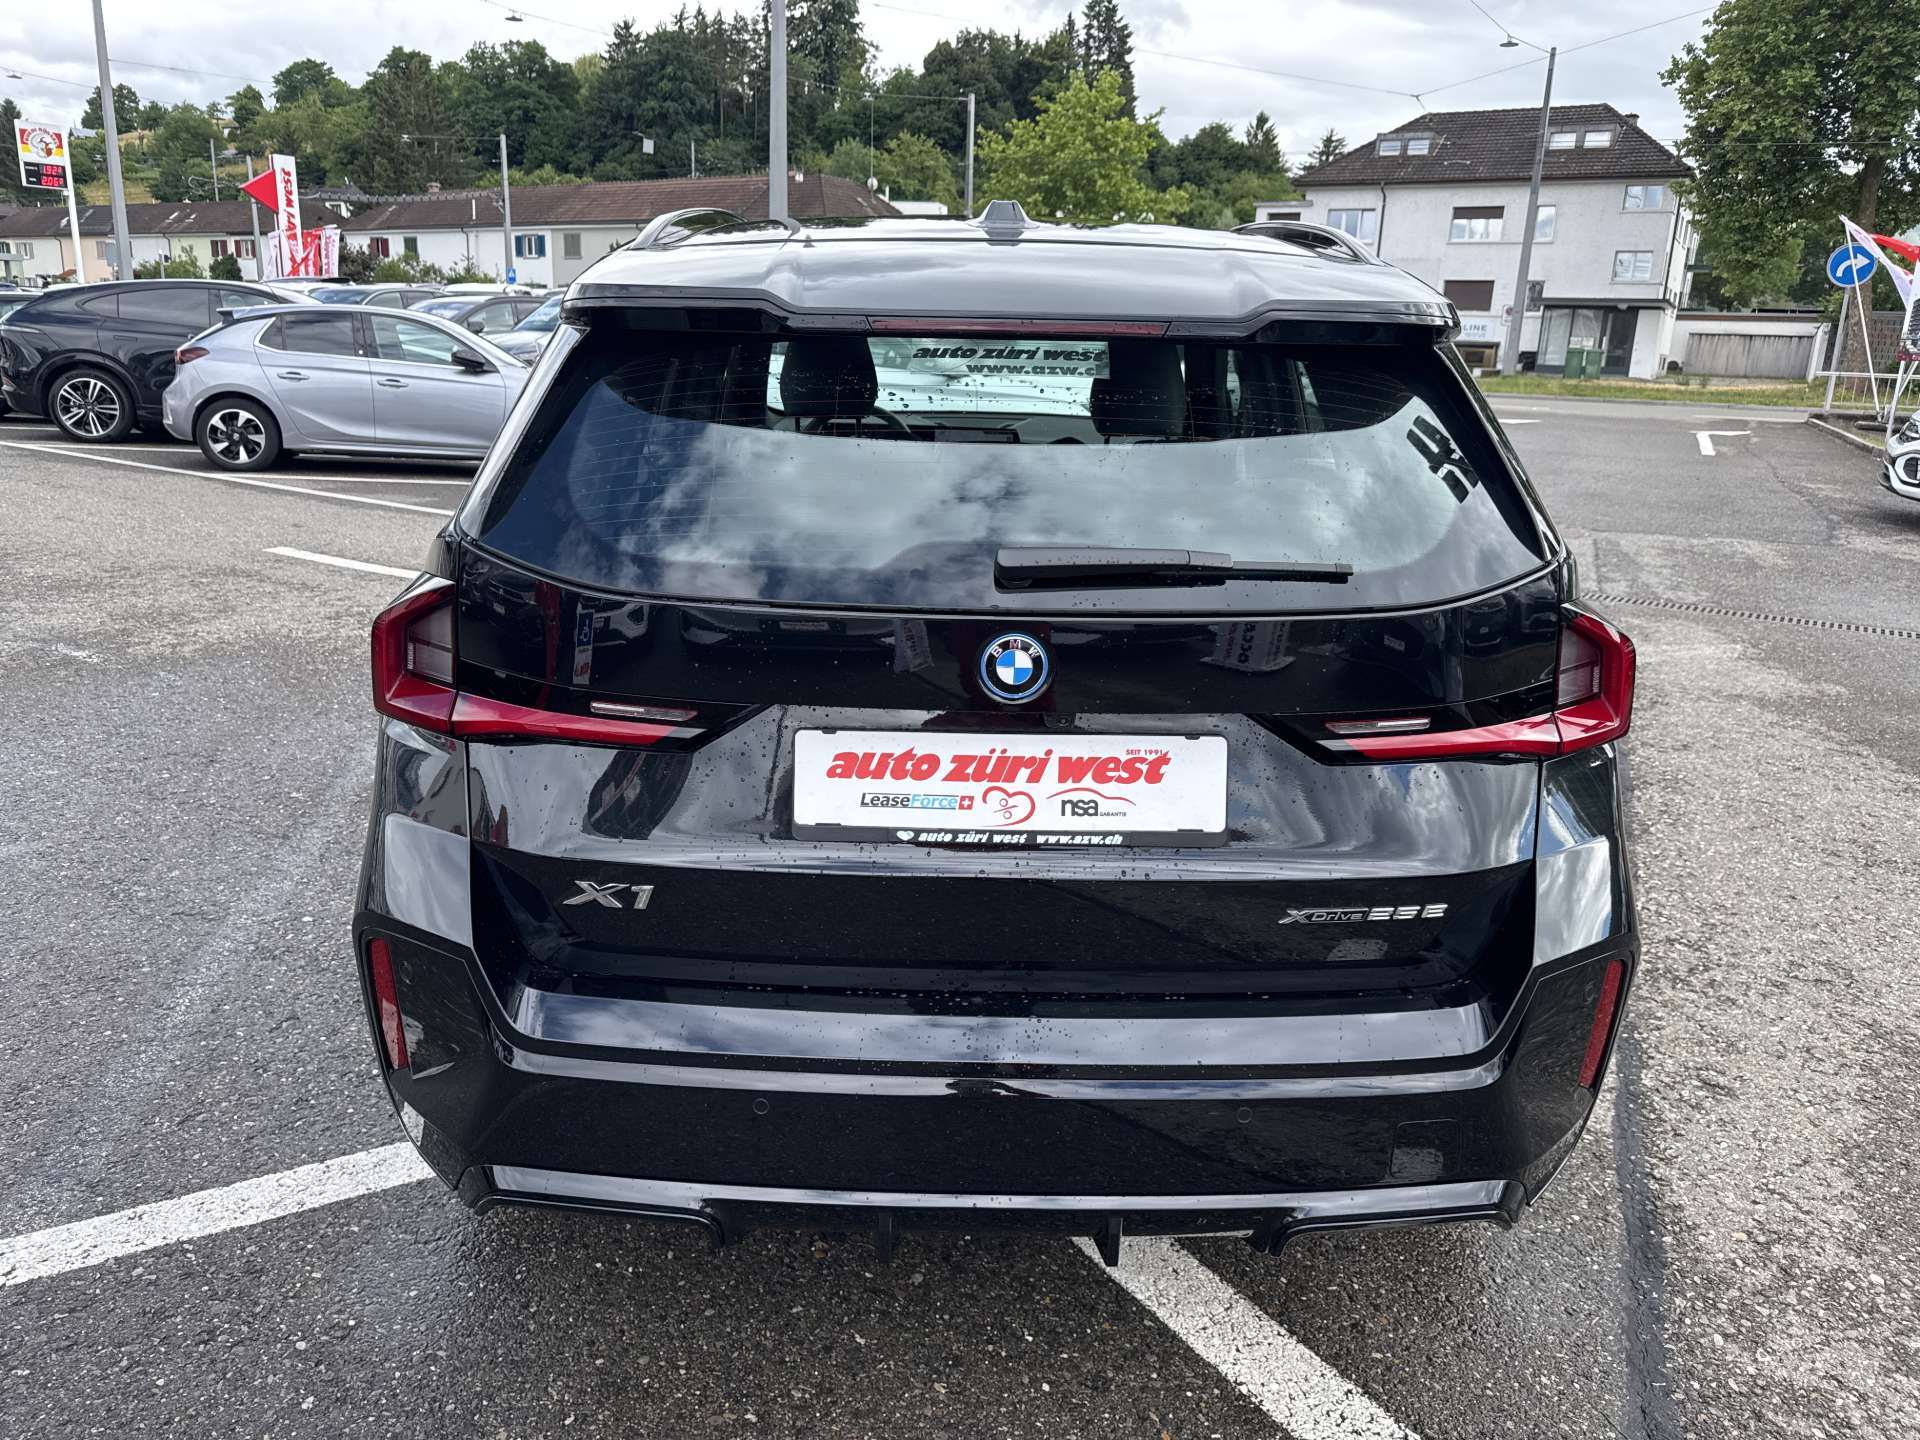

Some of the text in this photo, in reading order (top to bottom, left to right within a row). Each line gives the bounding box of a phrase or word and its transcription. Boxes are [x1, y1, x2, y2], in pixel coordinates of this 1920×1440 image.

[281, 167, 295, 208] west
[912, 346, 978, 358] auto
[977, 346, 1041, 360] züri
[966, 365, 1096, 376] www.azw.c
[991, 640, 1041, 659] BMW
[826, 746, 1172, 784] auto züri west
[861, 793, 958, 808] LeaseForce
[1061, 799, 1098, 817] nsa
[918, 831, 1027, 844] auto züri west
[1036, 834, 1124, 845] www.azw.ch
[562, 880, 655, 909] X1
